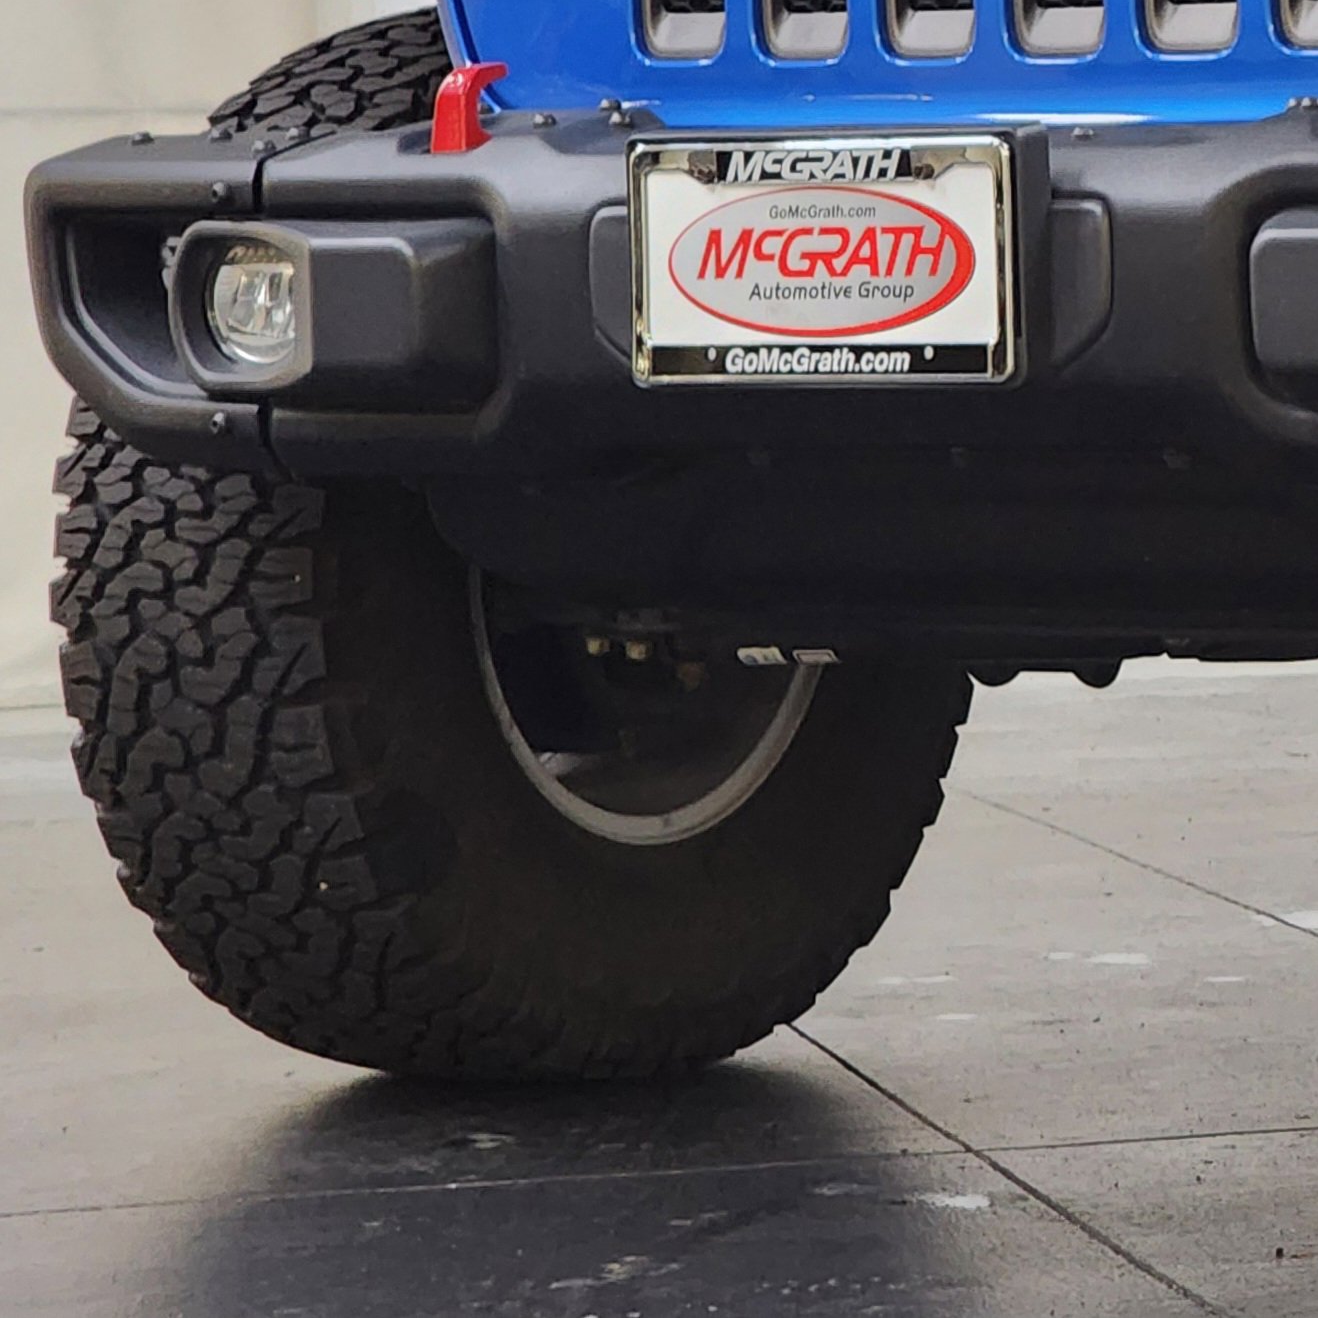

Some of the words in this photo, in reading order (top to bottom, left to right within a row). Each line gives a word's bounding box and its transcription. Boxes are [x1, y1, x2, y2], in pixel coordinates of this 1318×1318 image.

[769, 203, 876, 220] GoMcGrath.com
[748, 280, 853, 301] Automotive
[858, 280, 914, 303] Group
[725, 345, 911, 374] GoMcGrath.com
